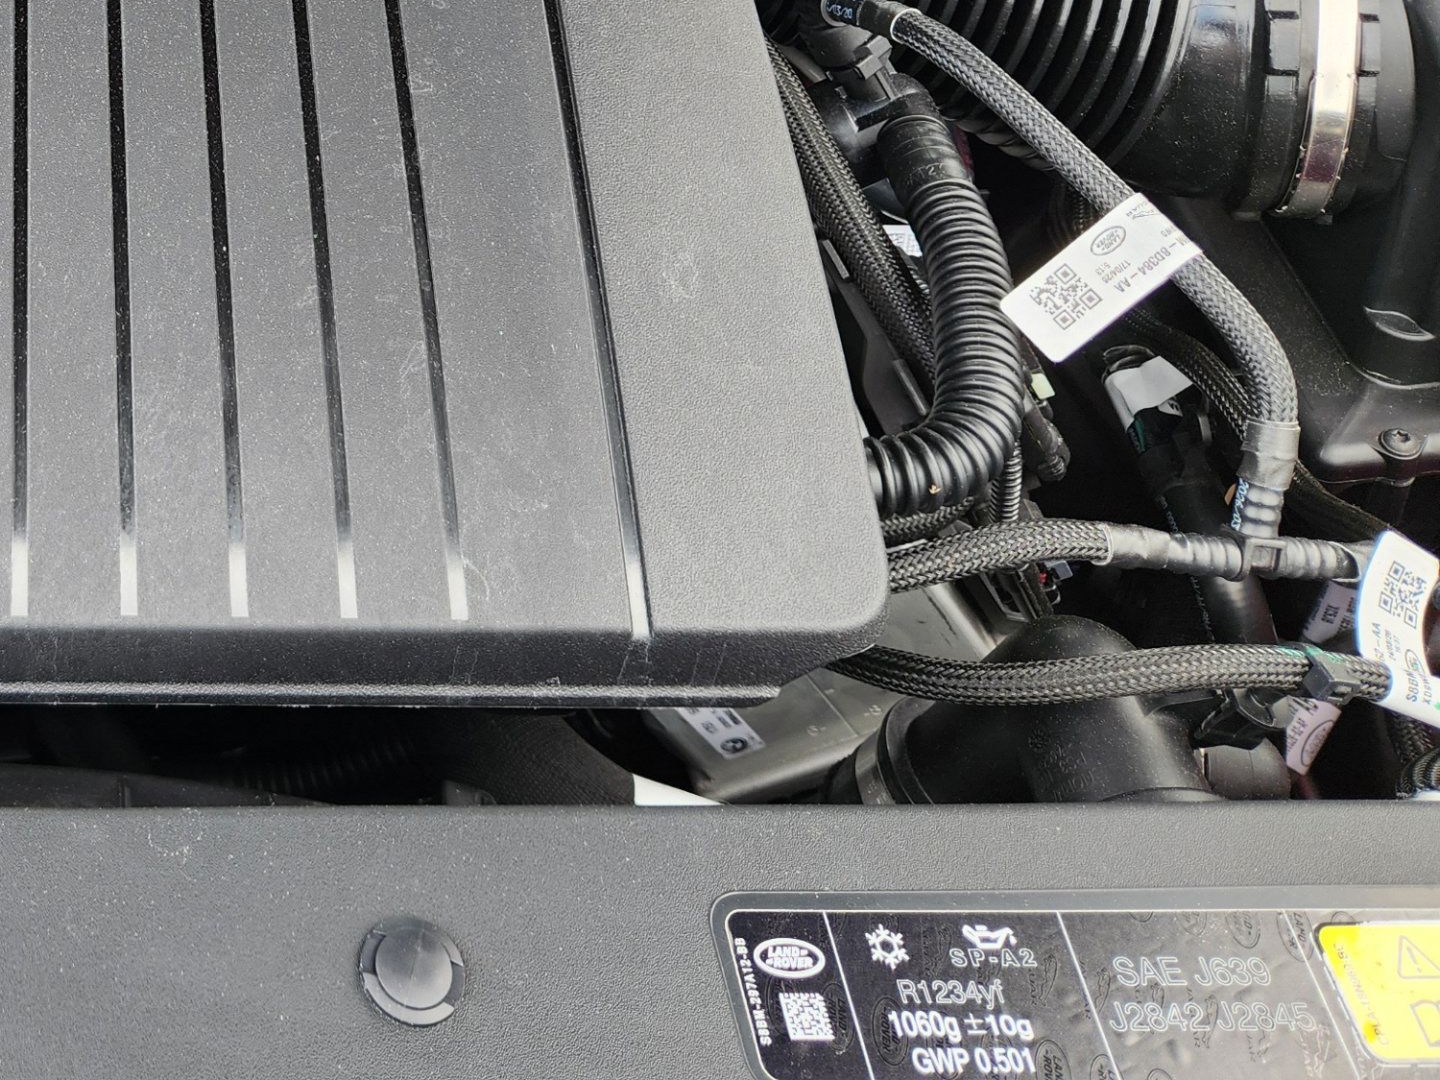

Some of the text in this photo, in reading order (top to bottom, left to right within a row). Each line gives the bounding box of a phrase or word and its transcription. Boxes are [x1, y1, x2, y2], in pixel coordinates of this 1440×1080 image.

[950, 948, 1038, 967] SP-A2
[1112, 956, 1271, 987] SAE J639
[896, 979, 1005, 1009] R1234yf
[888, 1011, 1034, 1043] 1060g ±10g
[1109, 1000, 1317, 1033] J2842 J2845
[912, 1047, 1037, 1074] GWP 0.501
